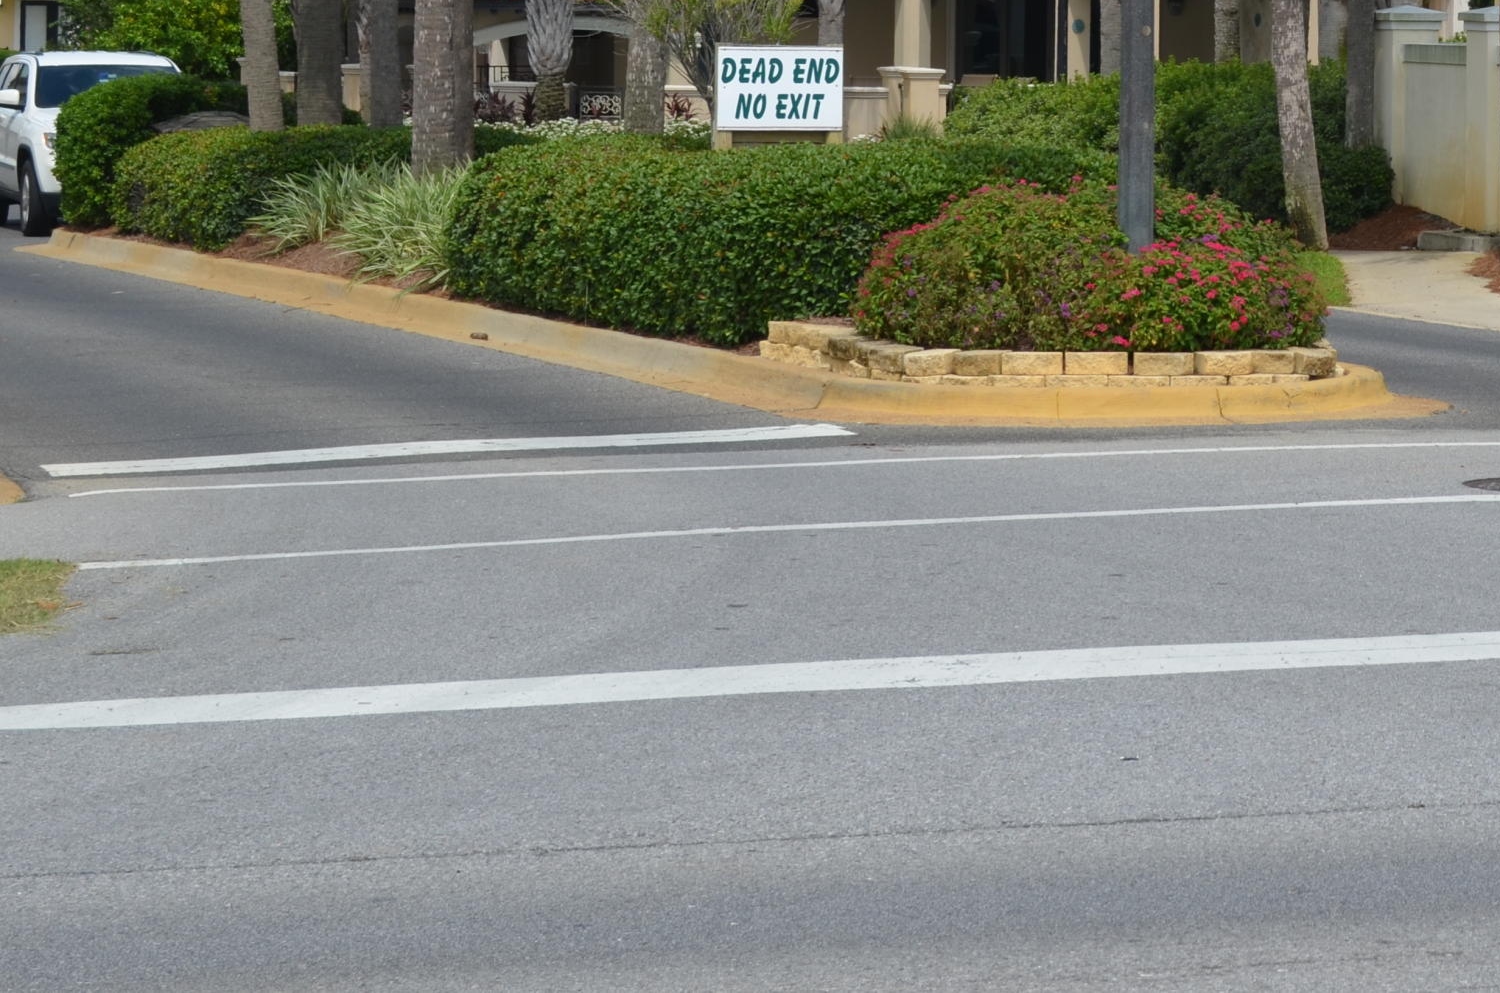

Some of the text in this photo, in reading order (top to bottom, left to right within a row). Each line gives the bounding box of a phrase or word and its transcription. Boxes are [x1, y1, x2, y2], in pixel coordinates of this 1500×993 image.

[721, 57, 840, 84] DEAD END
[735, 93, 826, 120] NO EXIT
